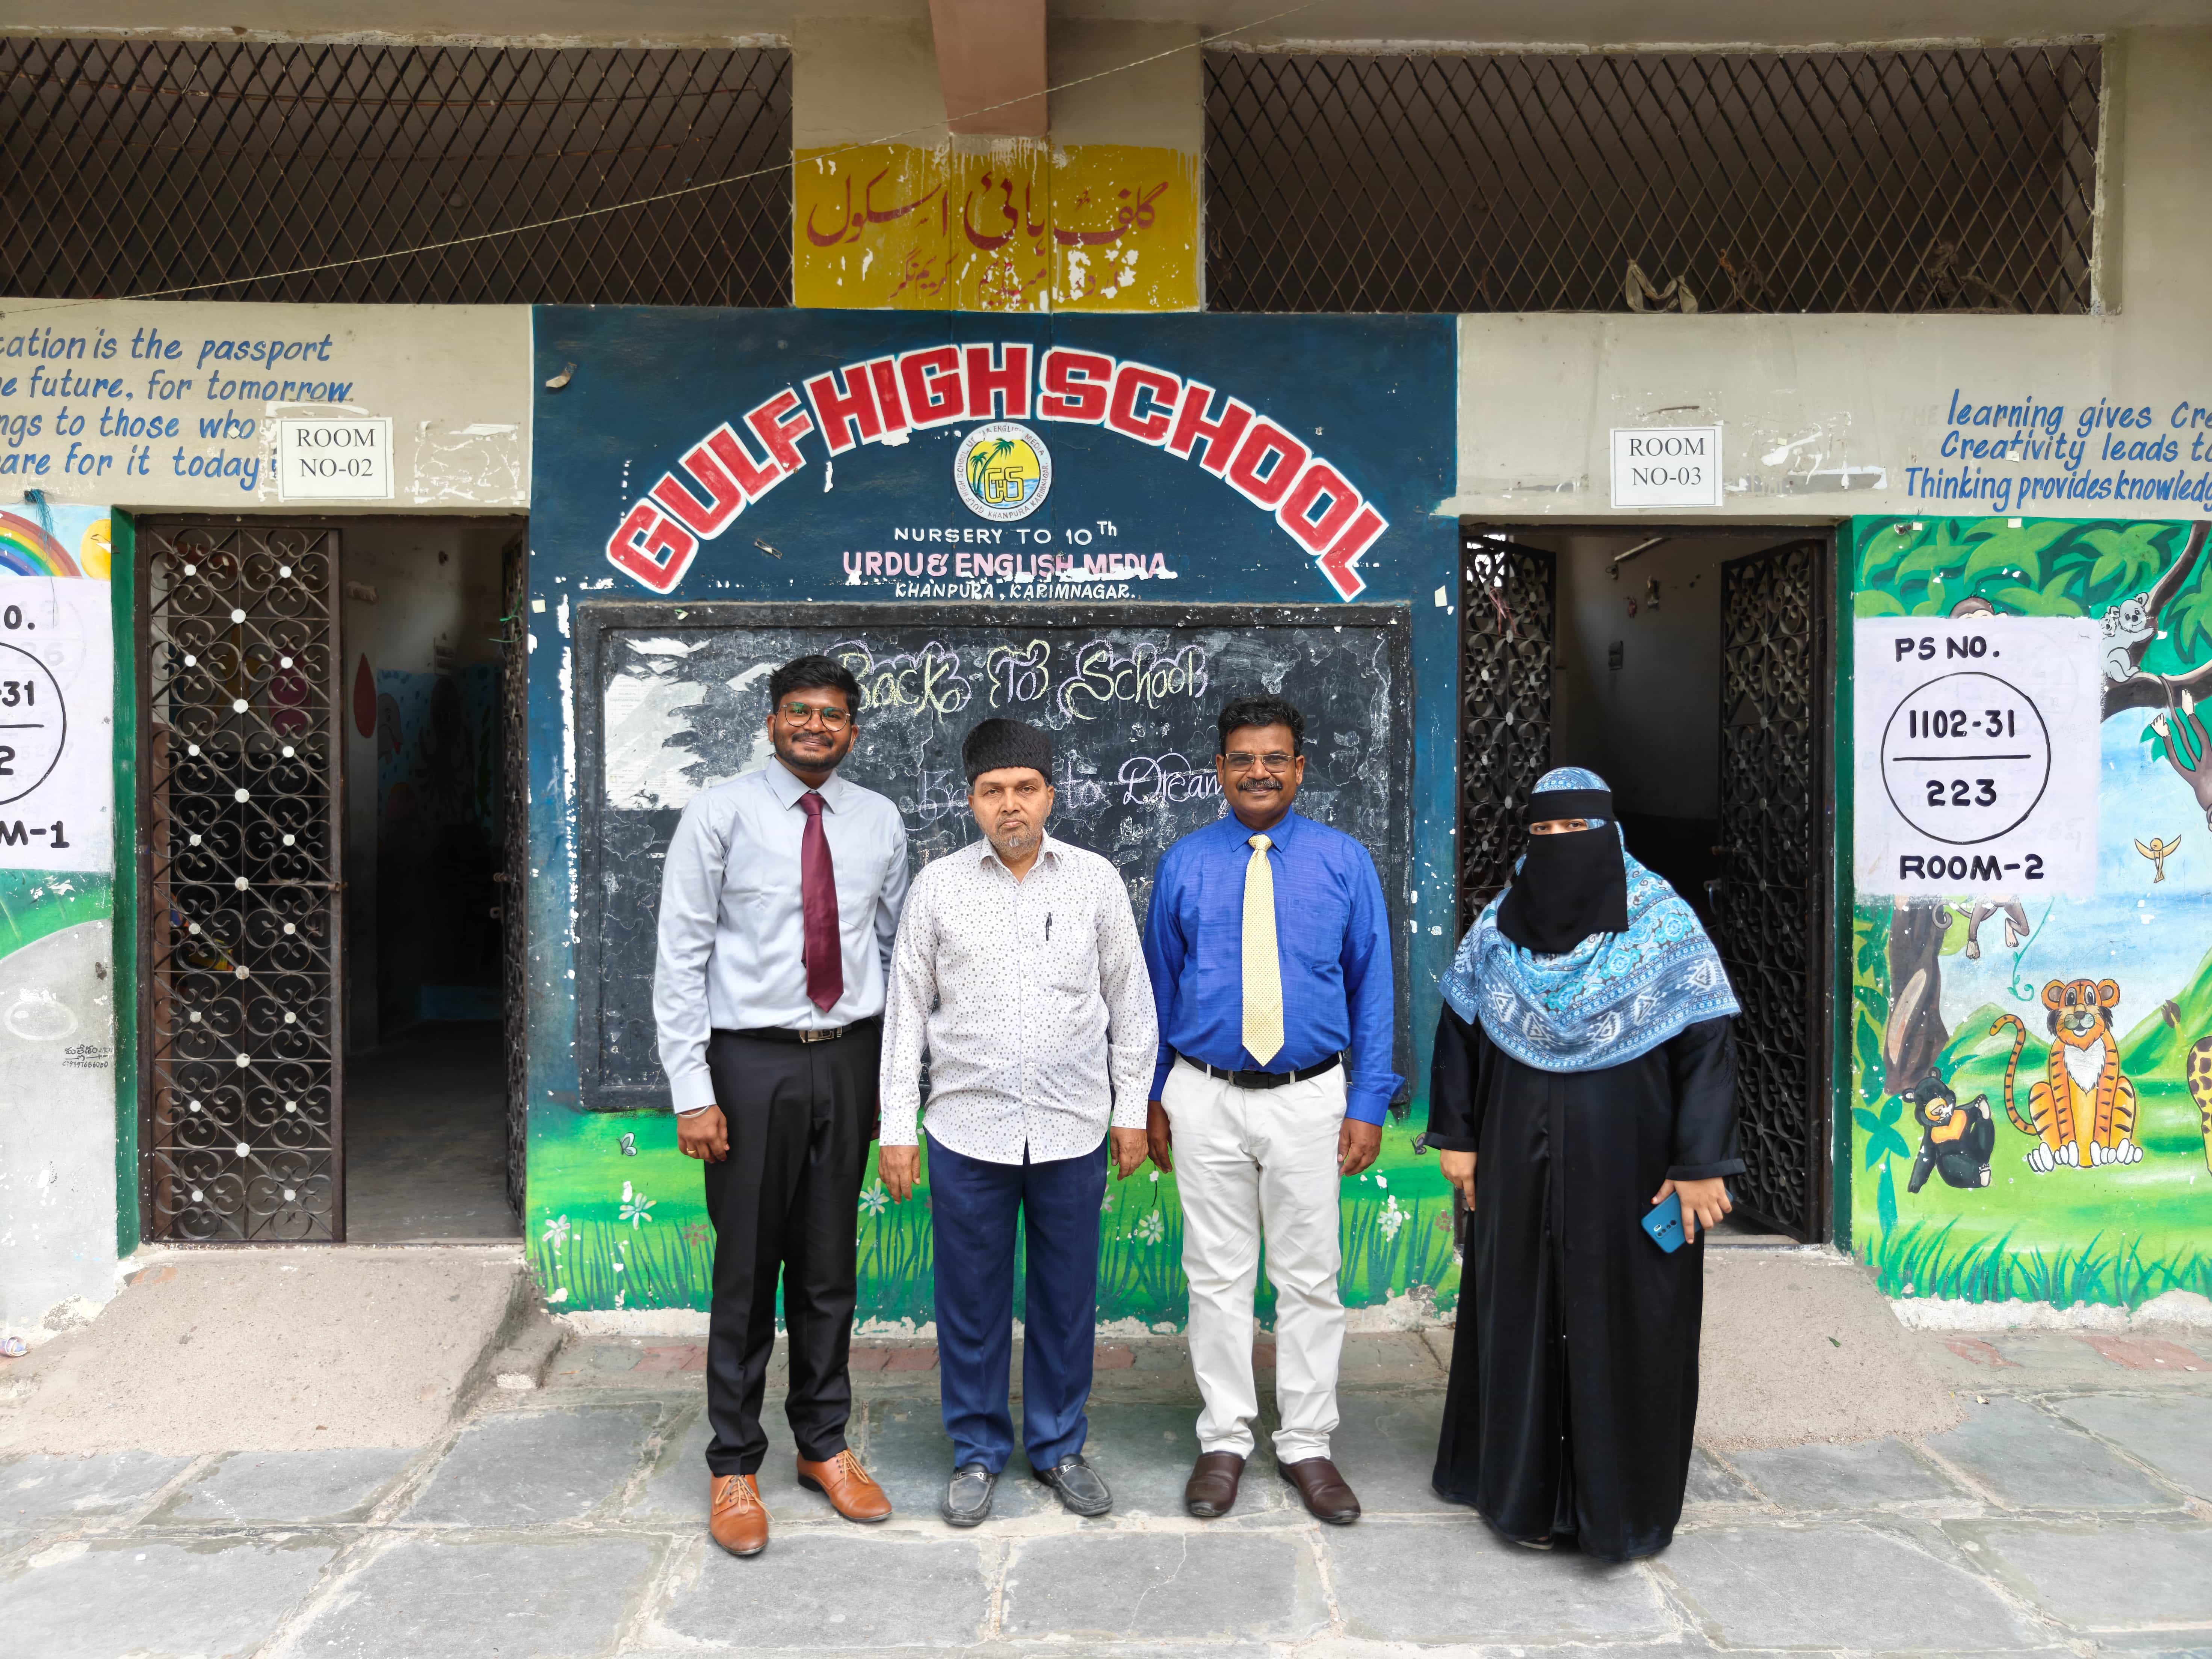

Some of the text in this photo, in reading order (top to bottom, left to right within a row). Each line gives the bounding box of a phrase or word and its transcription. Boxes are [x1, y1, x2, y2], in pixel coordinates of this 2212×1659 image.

[0, 327, 332, 369] ation is the passport
[29, 365, 134, 400] future,
[147, 368, 192, 400] for
[209, 369, 354, 403] tomorrow
[56, 406, 85, 437] to
[99, 406, 180, 439] those
[199, 409, 256, 439] who
[1947, 388, 2065, 440] learning
[2076, 397, 2153, 439] gives
[297, 429, 375, 447] ROOM
[1025, 433, 1045, 456] MEDIA
[1629, 438, 1705, 456] ROOM
[1941, 429, 2086, 472] Creativity
[2102, 432, 2179, 462] leads
[0, 453, 51, 476] are
[64, 442, 113, 476] for
[127, 446, 150, 476] it
[173, 447, 261, 491] today
[299, 458, 373, 477] NO-02
[606, 343, 1389, 602] GULF HIGH SCHOOL
[956, 450, 969, 479] SCHOOL
[1631, 467, 1702, 486] NO-03
[958, 480, 969, 497] HIGH
[1905, 466, 2013, 513] Thinking
[965, 497, 984, 514] GULF
[988, 506, 1030, 519] KHANPURA
[894, 527, 1003, 544] NURSERY
[1021, 529, 1052, 544] TO
[955, 552, 1073, 578] ENGLISH
[1083, 552, 1166, 579] MEDIA
[1009, 582, 1135, 601] KARIMNAGAR.
[1895, 635, 2000, 662] PS NO.
[1065, 646, 1195, 720] School
[1909, 709, 2016, 739] 1102-31
[1926, 778, 1997, 807] 223
[1899, 853, 2044, 881] ROOM-2
